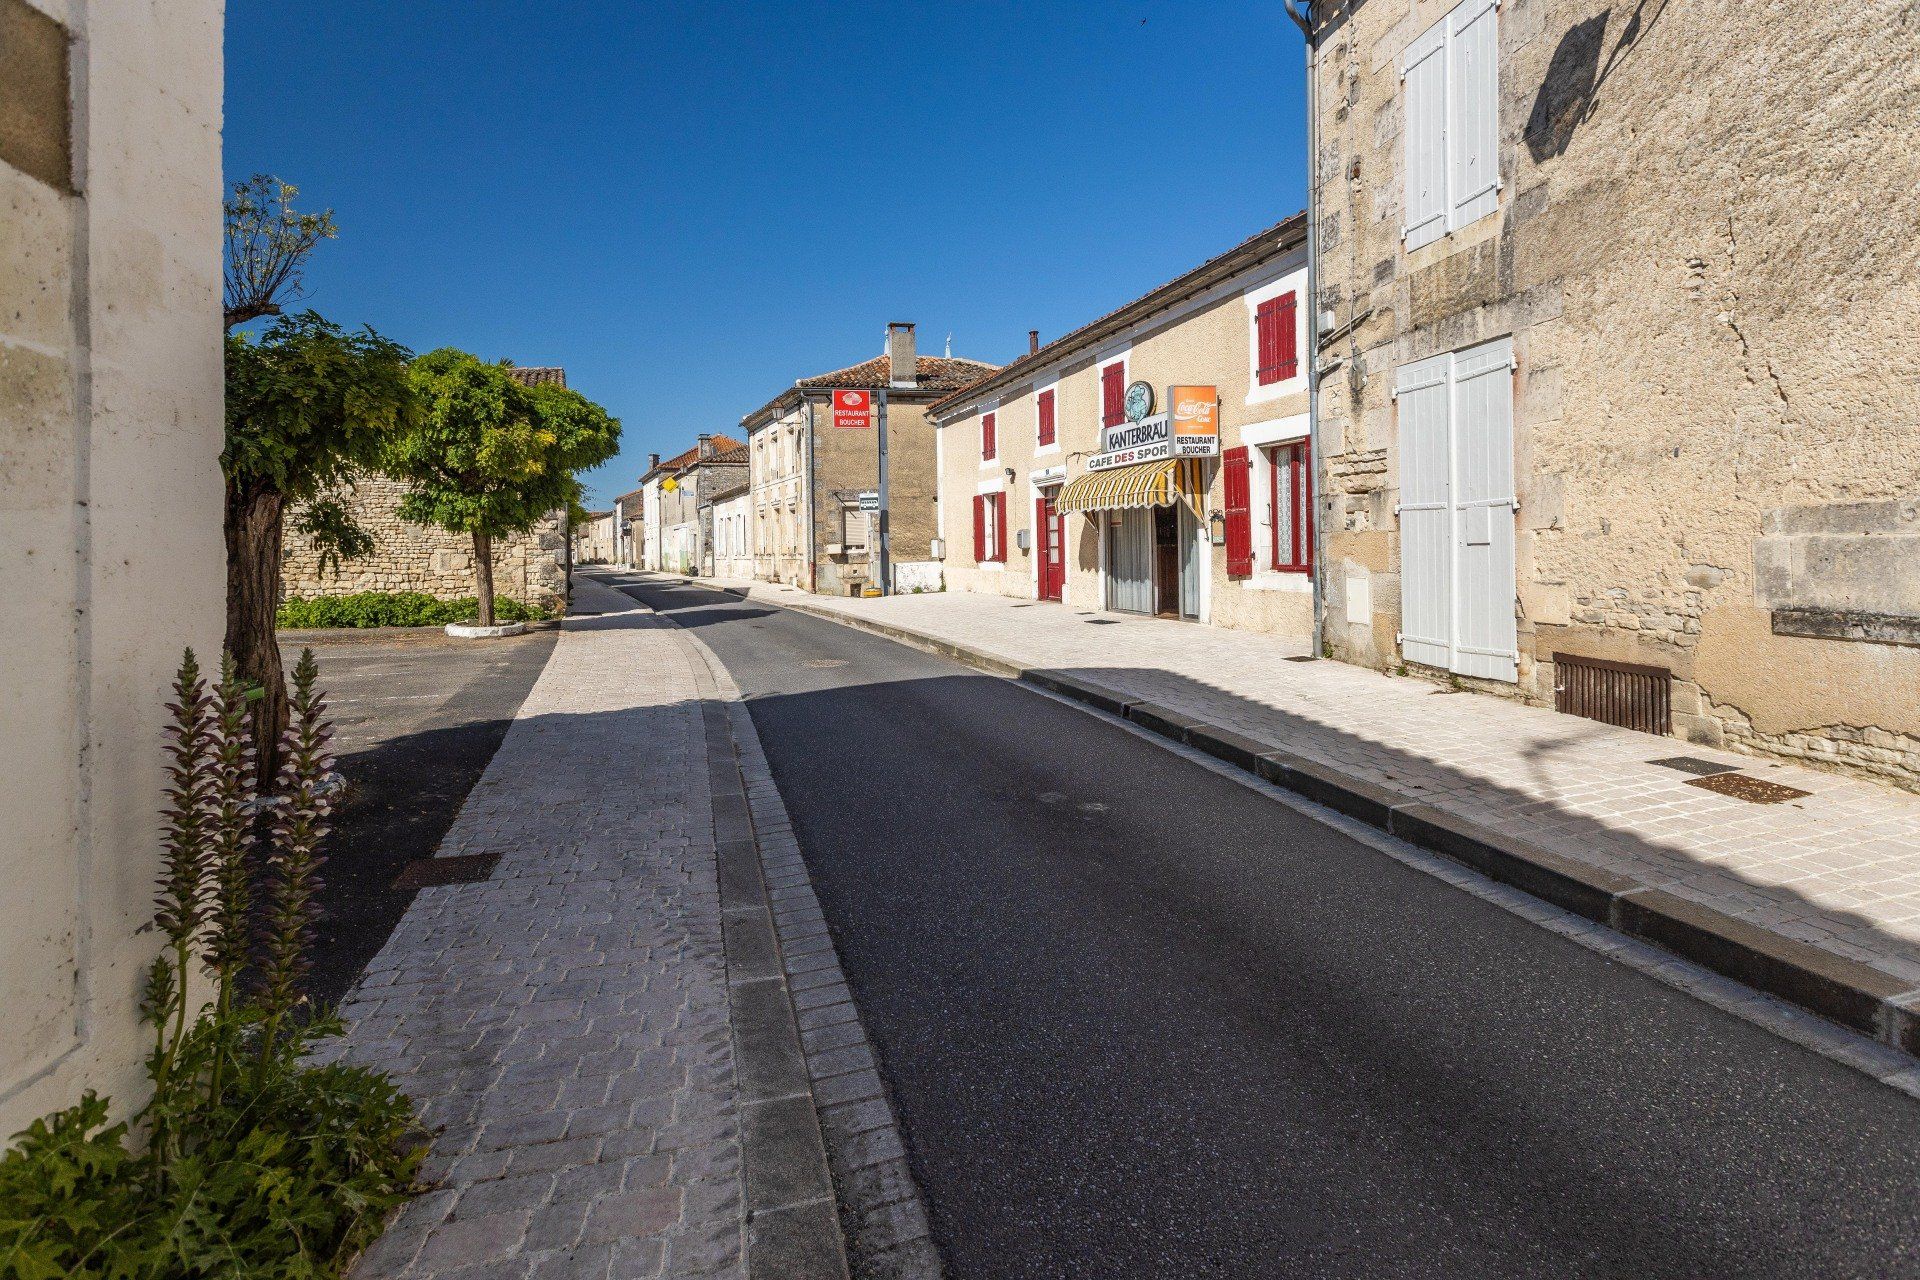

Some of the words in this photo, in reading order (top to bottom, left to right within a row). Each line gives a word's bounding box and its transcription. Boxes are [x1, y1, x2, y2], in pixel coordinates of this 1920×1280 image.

[1176, 436, 1215, 445] RESTAURANT
[1182, 446, 1211, 454] BOUCHER
[1089, 455, 1112, 469] CAFE
[1114, 451, 1134, 464] DES
